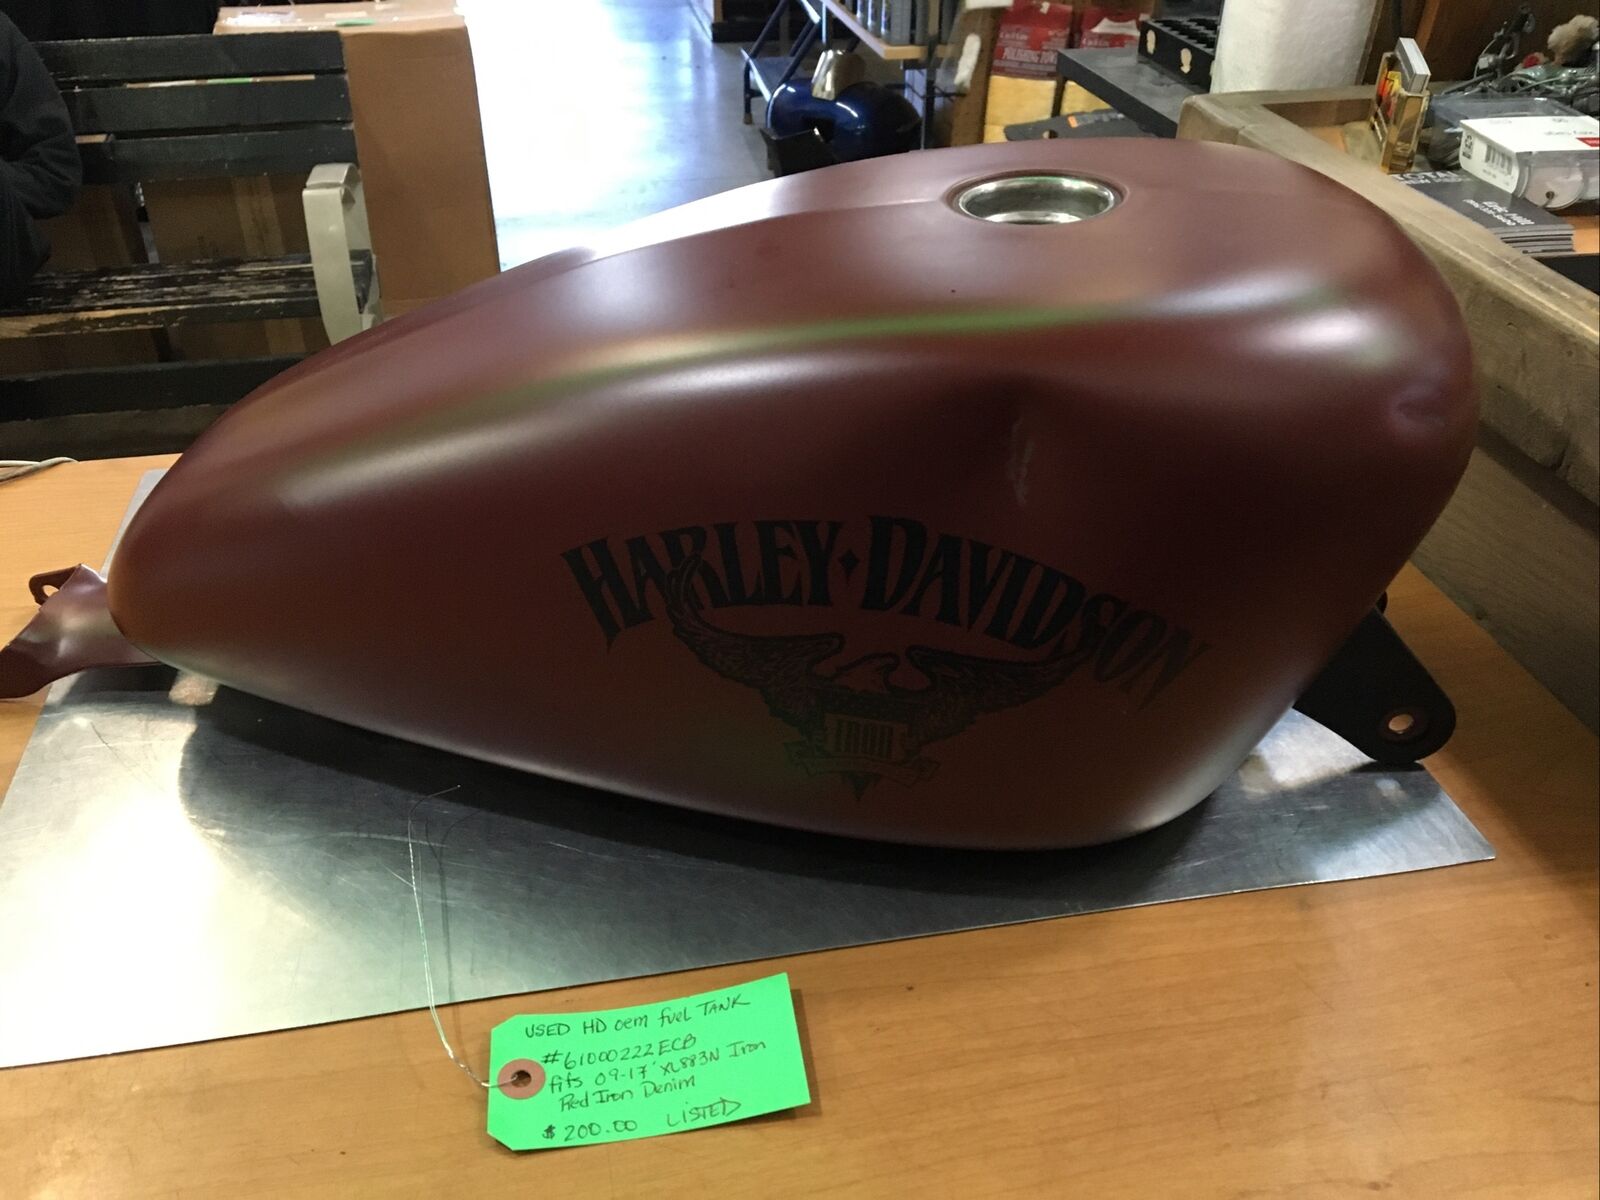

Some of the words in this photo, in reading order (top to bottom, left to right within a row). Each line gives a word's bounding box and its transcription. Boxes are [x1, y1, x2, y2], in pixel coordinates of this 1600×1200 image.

[560, 520, 845, 649] HARLEY
[864, 515, 1211, 710] DAVIDSON
[525, 1022, 571, 1039] USED
[582, 1017, 607, 1034] HD
[614, 1013, 649, 1032] oem
[698, 993, 751, 1019] TANK
[549, 1071, 584, 1095] fits
[727, 1039, 767, 1059] Iron
[558, 1094, 590, 1113] Red
[592, 1087, 634, 1105] Iron
[642, 1074, 696, 1099] Denim
